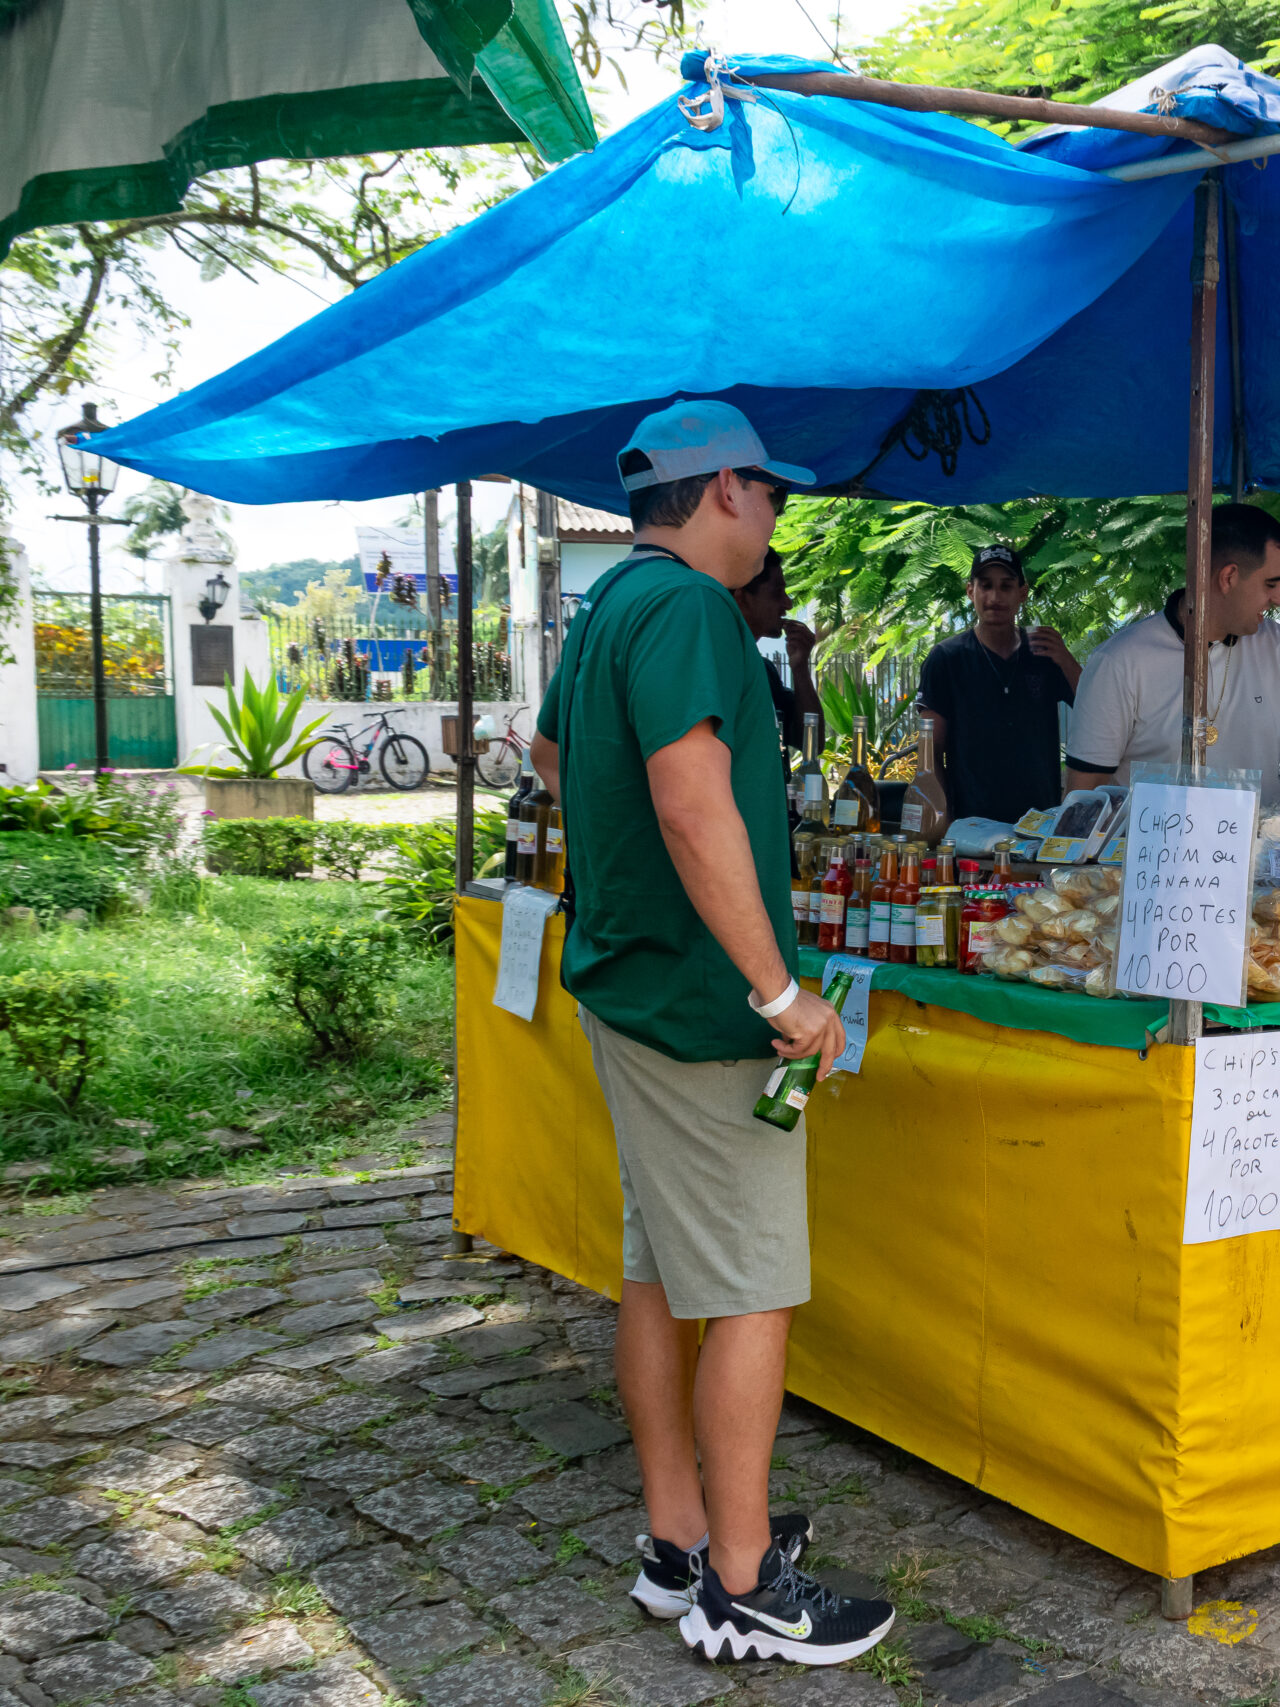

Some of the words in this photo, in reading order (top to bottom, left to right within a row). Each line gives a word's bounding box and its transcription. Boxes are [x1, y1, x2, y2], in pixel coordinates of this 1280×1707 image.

[1217, 820, 1238, 835] DE
[1136, 871, 1220, 891] BANANA
[1143, 898, 1236, 925] PACOTES
[1157, 927, 1199, 953] POR
[1123, 954, 1208, 994] 10,00
[1202, 1128, 1216, 1158] 4
[1229, 1158, 1263, 1179] POR
[1203, 1188, 1279, 1233] 10,00
